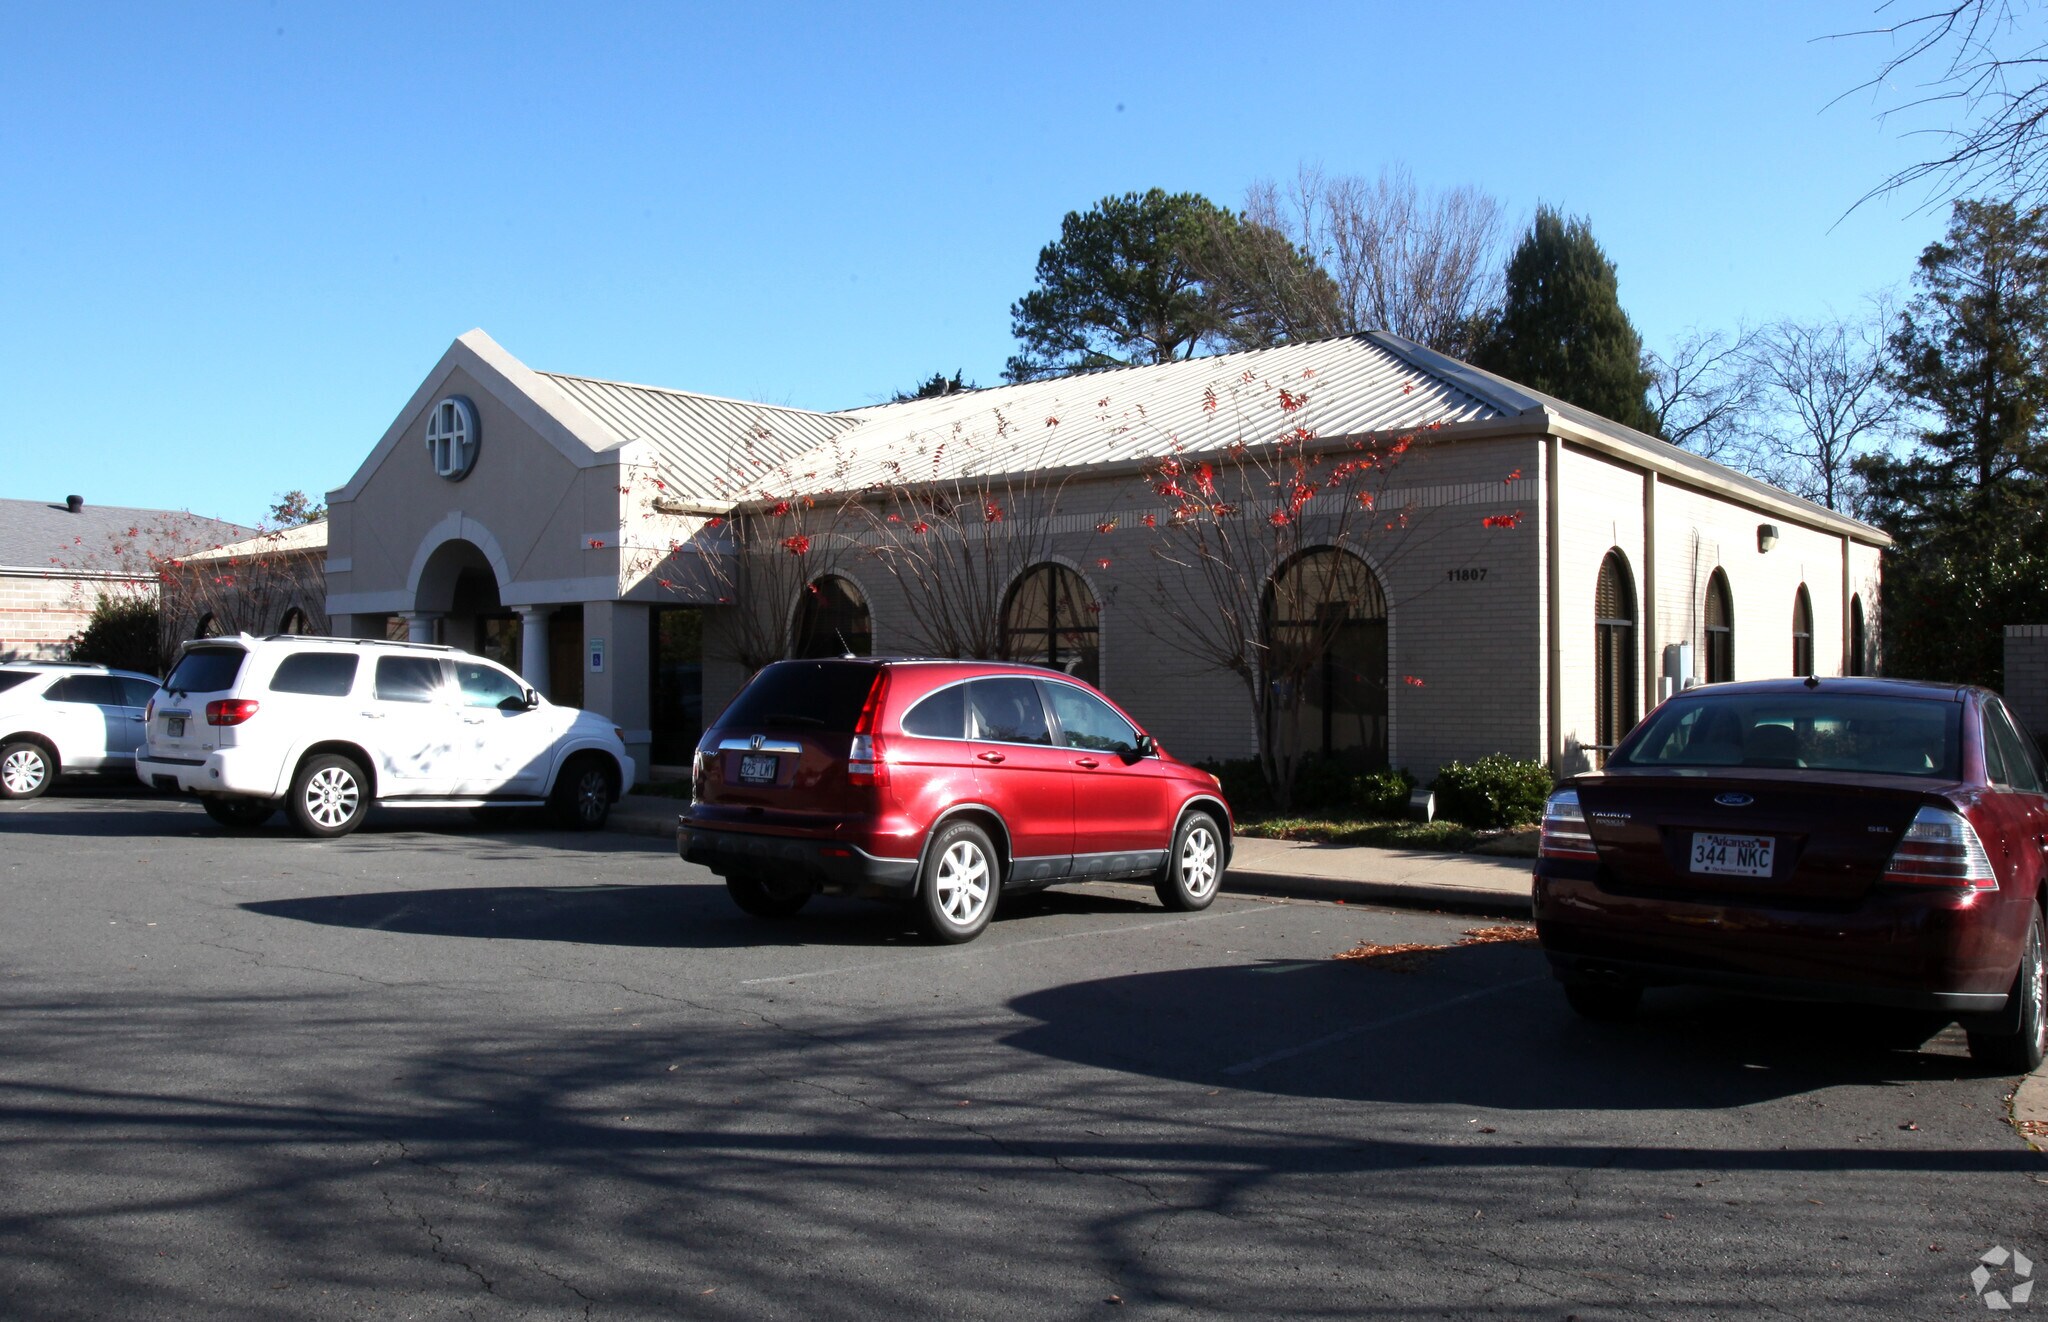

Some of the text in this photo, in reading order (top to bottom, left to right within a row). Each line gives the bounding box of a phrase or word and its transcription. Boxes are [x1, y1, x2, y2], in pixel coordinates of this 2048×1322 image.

[1447, 569, 1487, 581] 11807
[741, 762, 774, 777] 325 LMY
[1711, 836, 1756, 848] Arkansas
[1695, 845, 1769, 868] 344 NKC
